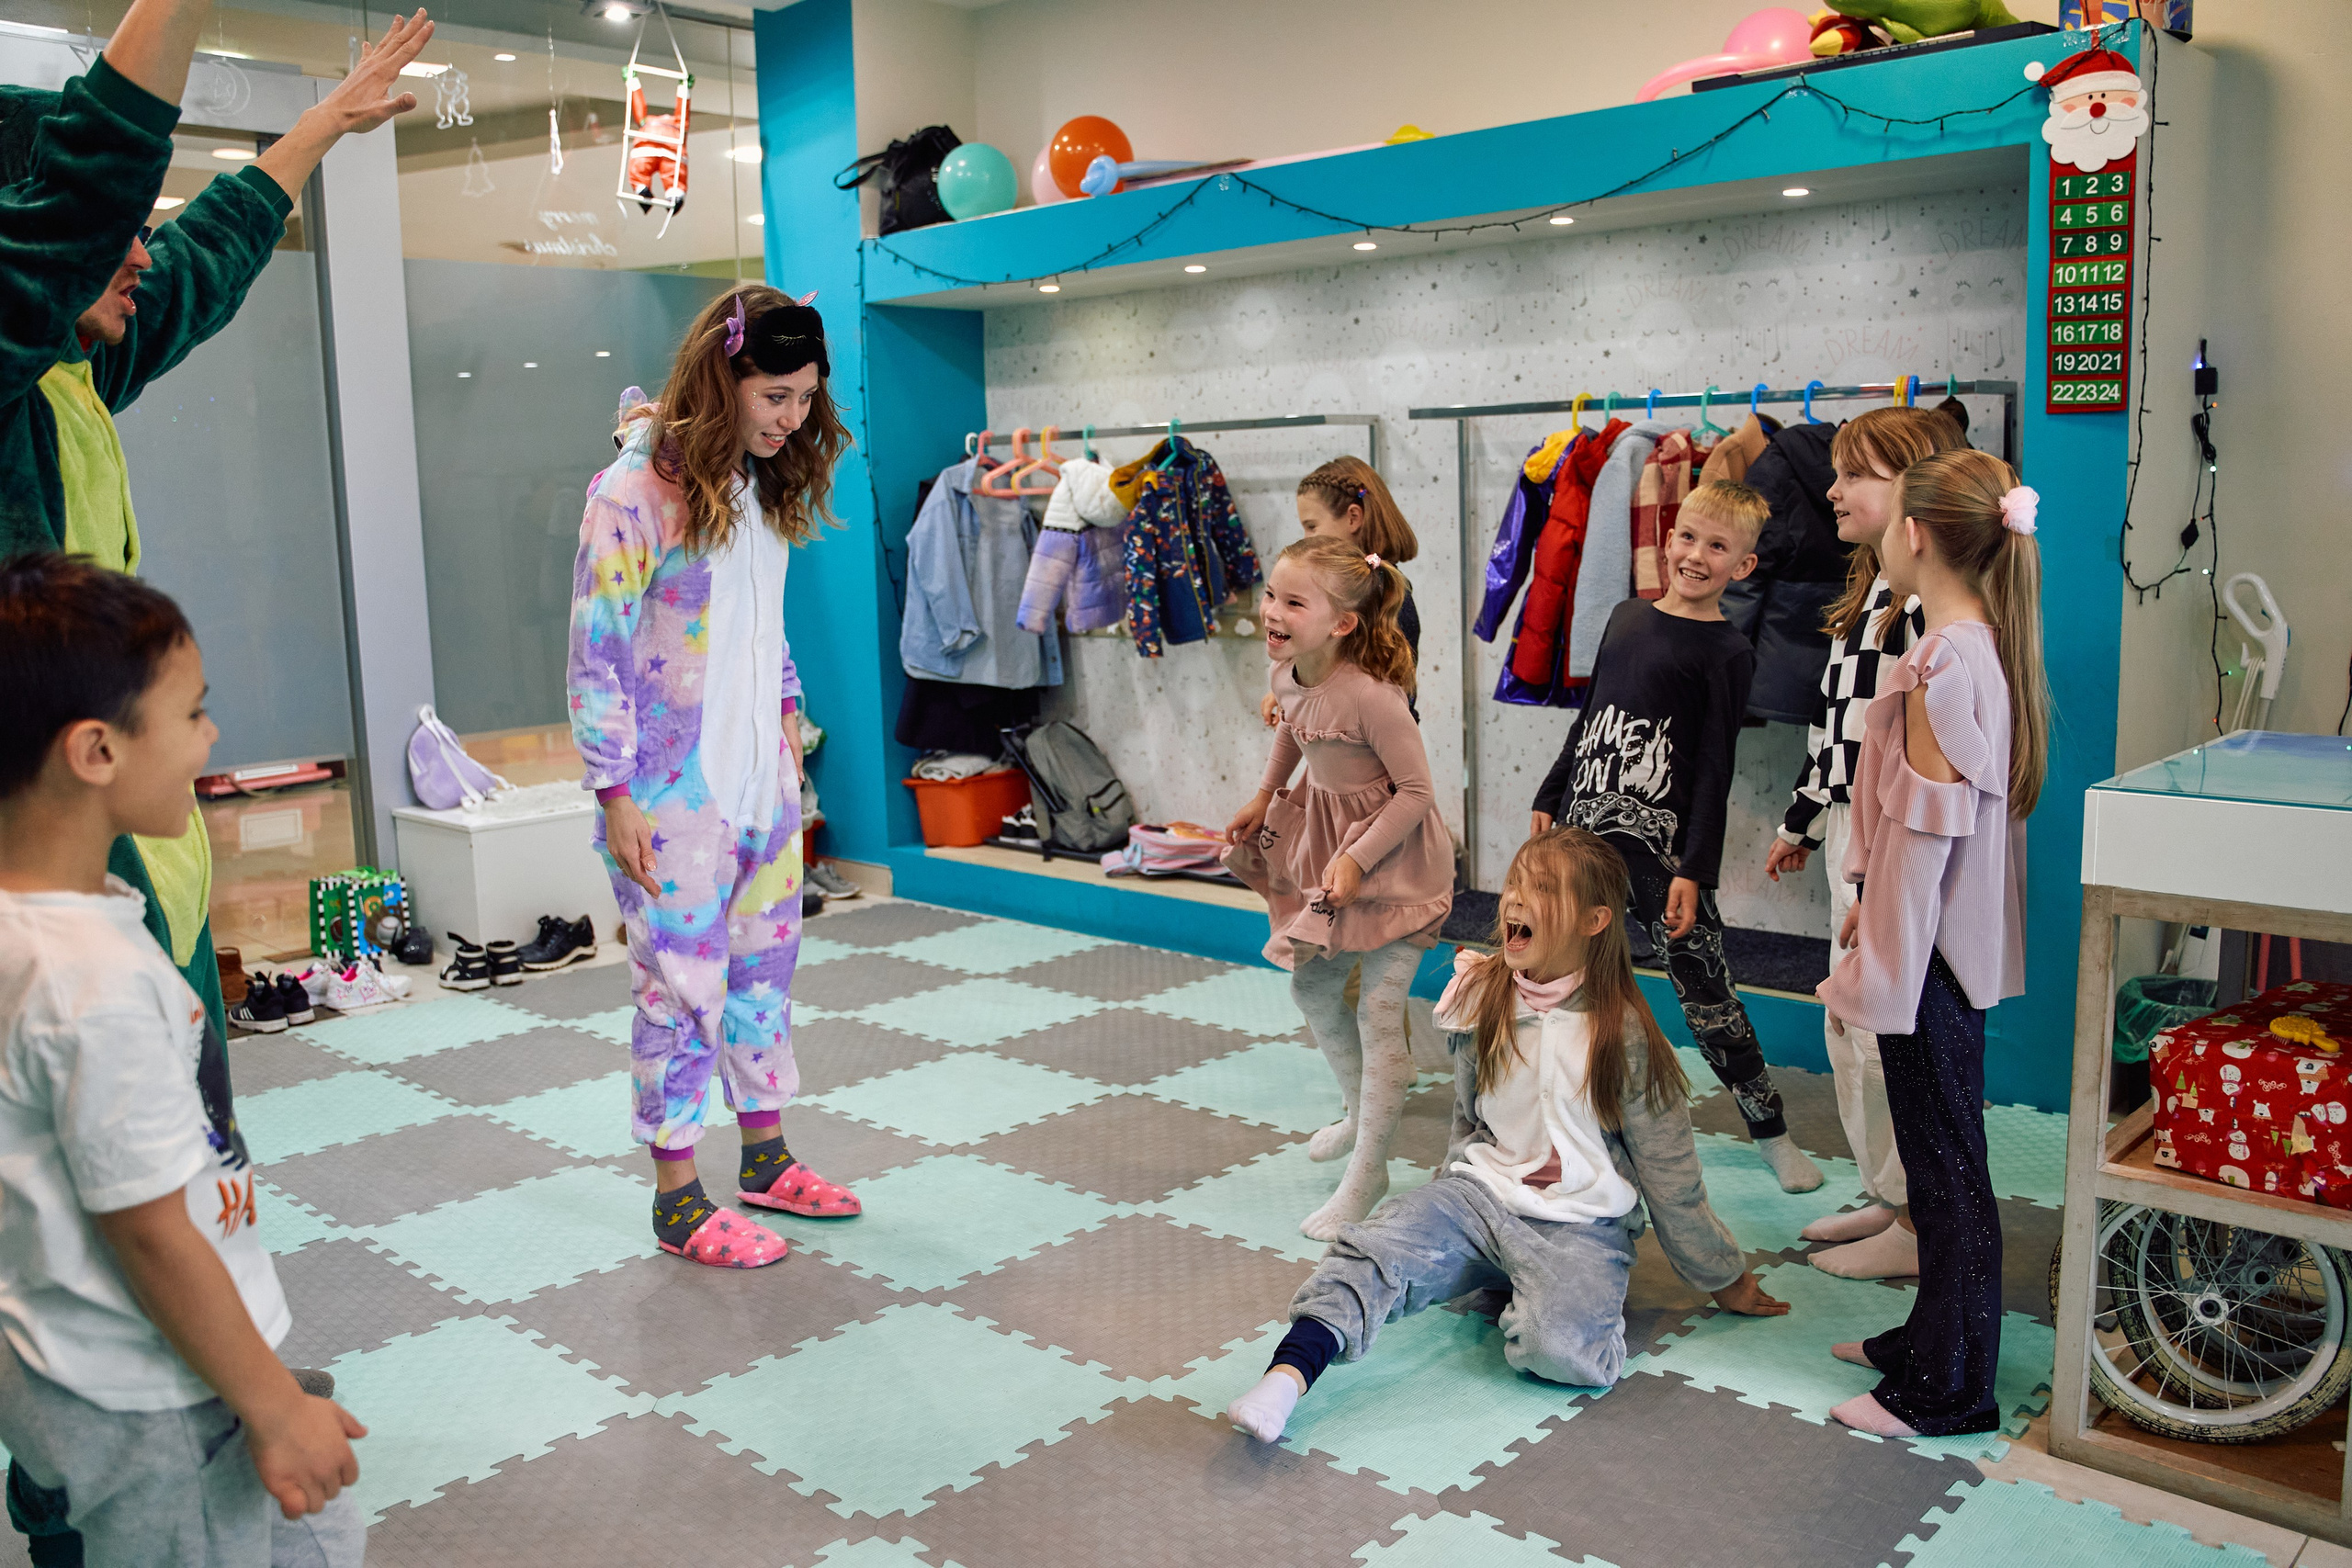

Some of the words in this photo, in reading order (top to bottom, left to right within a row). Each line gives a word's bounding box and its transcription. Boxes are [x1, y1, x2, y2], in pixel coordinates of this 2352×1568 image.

[2062, 178, 2071, 197] 1
[2086, 176, 2098, 195] 2
[2110, 175, 2124, 193] 3
[2060, 208, 2073, 225] 4
[2086, 206, 2098, 224] 5
[2110, 204, 2123, 222] 6
[1723, 221, 1811, 263] DREAM
[2062, 237, 2074, 254] 7
[2085, 235, 2098, 253] 8
[2109, 233, 2122, 252] 9
[2055, 265, 2076, 284] 10
[2079, 265, 2098, 283] 11
[2103, 264, 2124, 282] 12
[1625, 270, 1708, 310] DREAM
[2054, 295, 2075, 313] 13
[2077, 294, 2098, 312] 14
[2101, 293, 2122, 311] 15
[2054, 325, 2075, 343] 16
[2077, 323, 2098, 342] 17
[2100, 322, 2122, 341] 18
[1825, 325, 1919, 367] DREAM
[2054, 354, 2075, 371] 19
[2077, 354, 2100, 371] 20
[2100, 353, 2121, 371] 21
[2052, 384, 2075, 401] 22
[2075, 383, 2098, 401] 23
[2098, 383, 2120, 400] 24
[1573, 752, 1616, 794] ON
